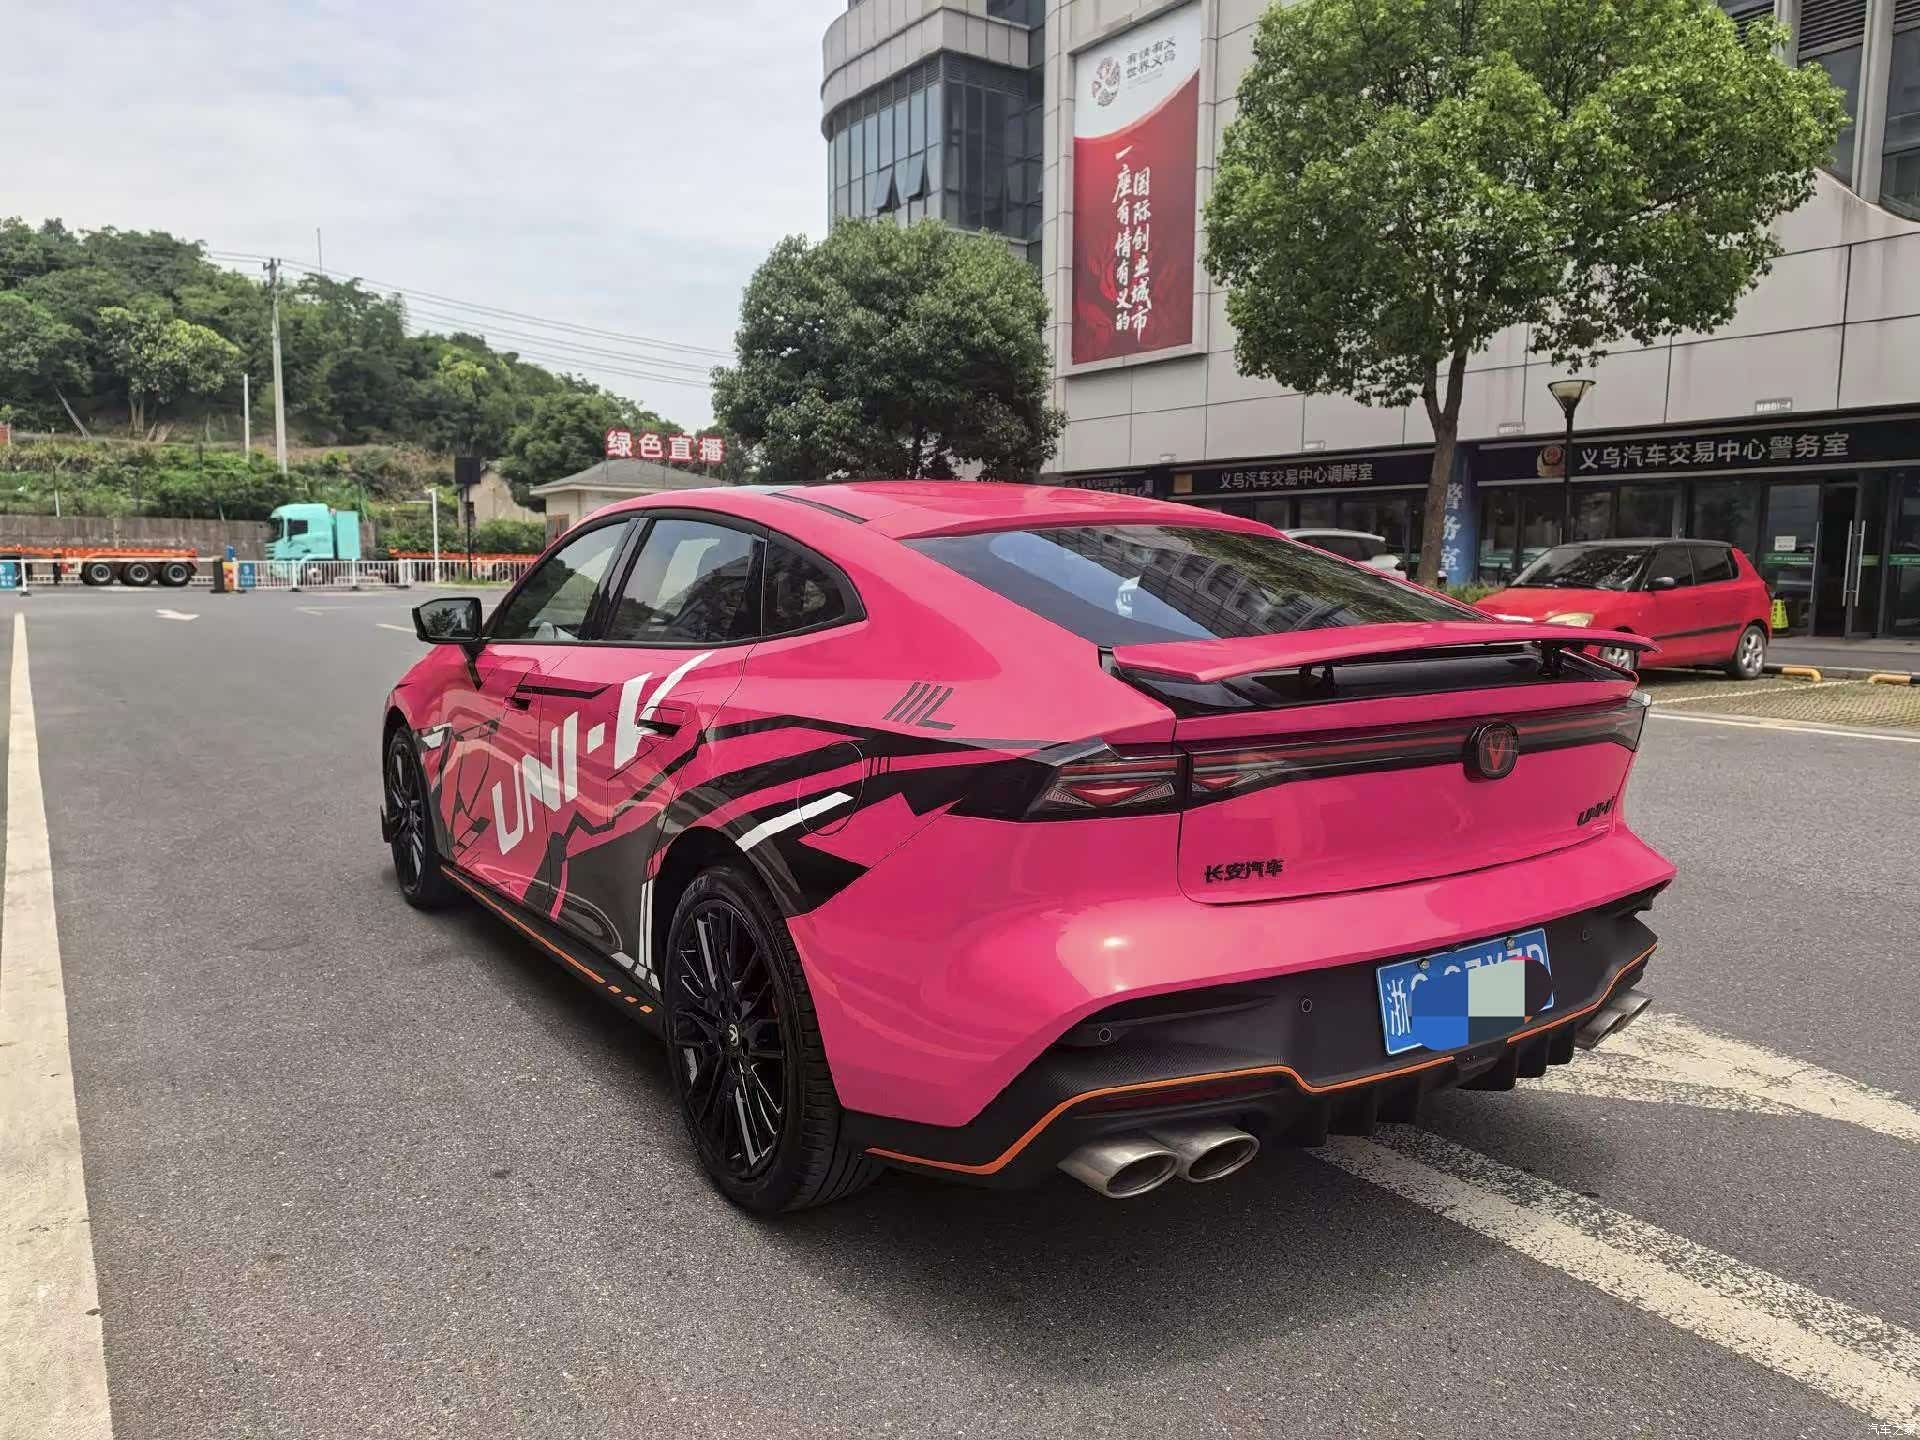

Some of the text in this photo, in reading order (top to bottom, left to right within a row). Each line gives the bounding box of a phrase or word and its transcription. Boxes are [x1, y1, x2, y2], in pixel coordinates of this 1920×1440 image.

[1112, 145, 1133, 331] 一座有情有义的
[1131, 166, 1152, 343] 国际创业城市
[606, 429, 723, 462] 绿色直播
[1579, 432, 1849, 470] 义乌汽车交易中心警务室
[1219, 462, 1373, 489] 义乌汽车交易中心调解室
[1205, 859, 1284, 883] 长安汽车
